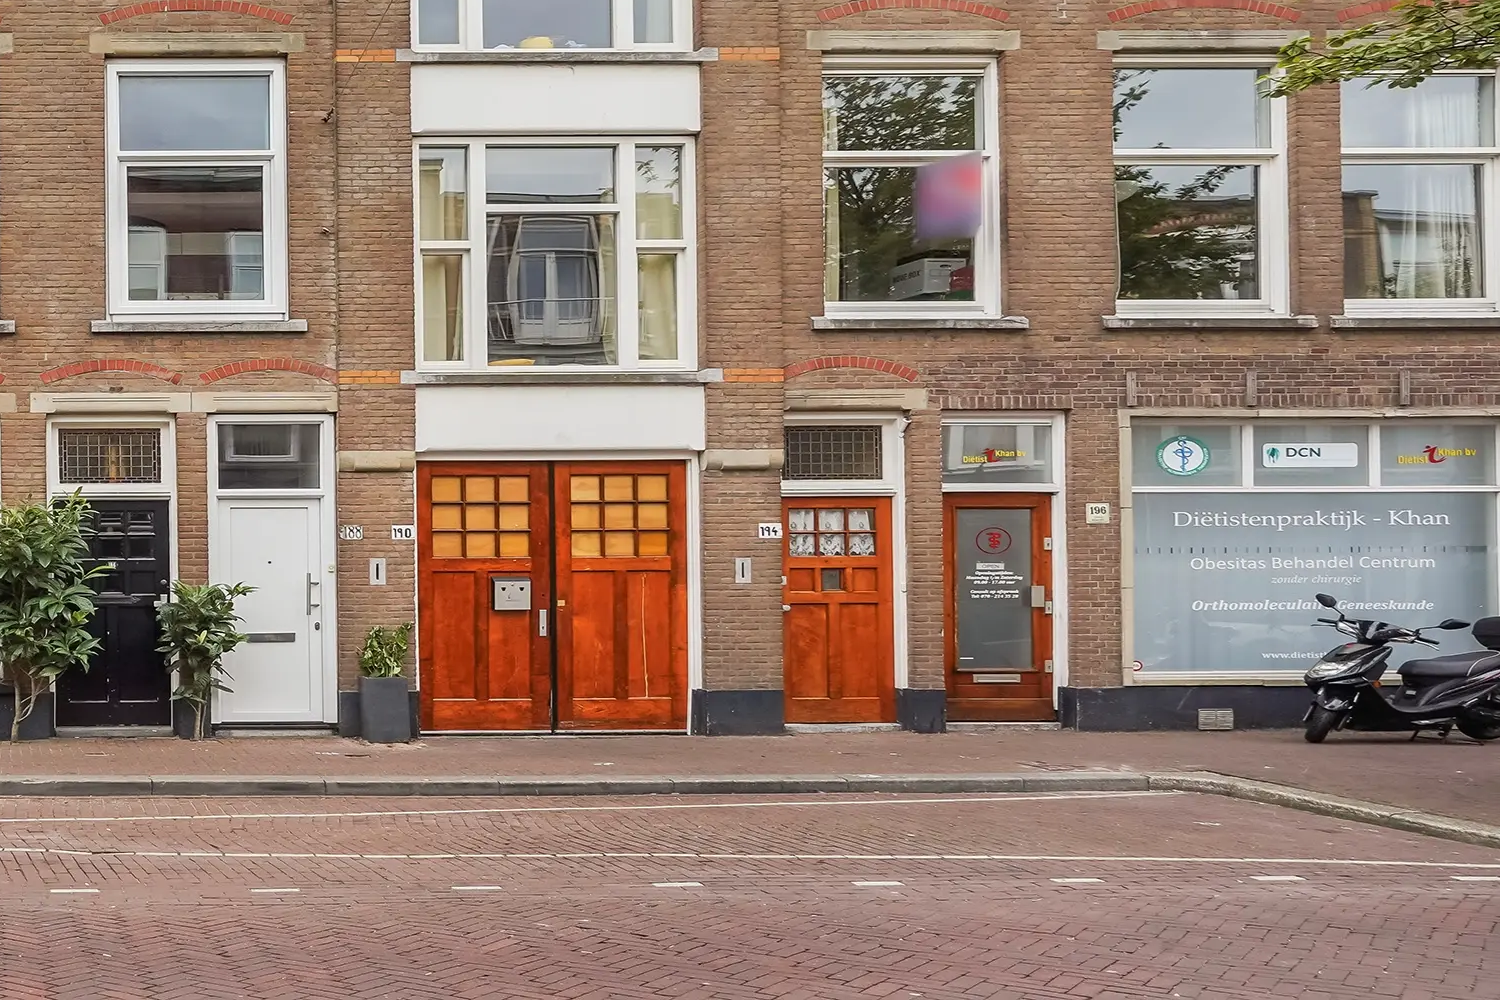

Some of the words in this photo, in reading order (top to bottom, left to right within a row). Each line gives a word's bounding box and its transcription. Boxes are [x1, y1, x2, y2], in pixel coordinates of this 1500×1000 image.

[1286, 447, 1321, 457] DCN
[1438, 448, 1462, 456] Khan
[1464, 448, 1477, 456] bv
[1090, 506, 1107, 514] 196
[1172, 511, 1367, 531] Diëtistenpraktijk
[1388, 510, 1451, 526] Khan
[344, 526, 362, 539] 188
[393, 528, 412, 538] 190
[760, 526, 778, 536] 194
[1190, 558, 1266, 570] Obesitas
[1272, 556, 1353, 569] Behandel
[1359, 556, 1436, 568] Centrum
[1271, 575, 1308, 584] zonder
[1312, 574, 1362, 585] chirurgie
[1337, 600, 1434, 610] Geneeskunde
